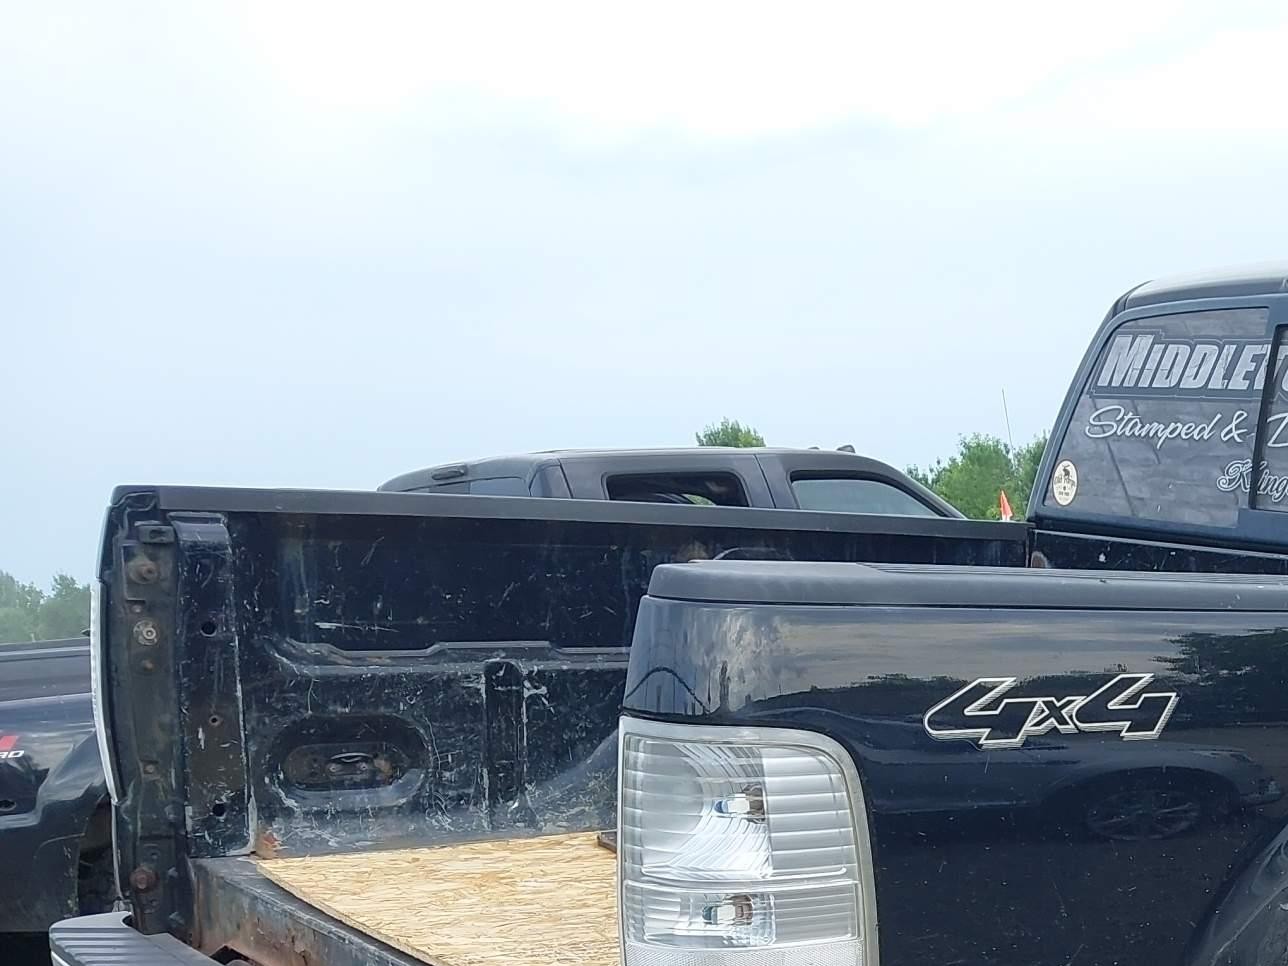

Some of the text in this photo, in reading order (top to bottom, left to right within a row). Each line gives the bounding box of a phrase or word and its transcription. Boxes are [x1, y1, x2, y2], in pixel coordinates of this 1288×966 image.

[1084, 404, 1222, 450] Stamped
[1220, 410, 1249, 443] &
[923, 672, 1180, 750] 4x4
